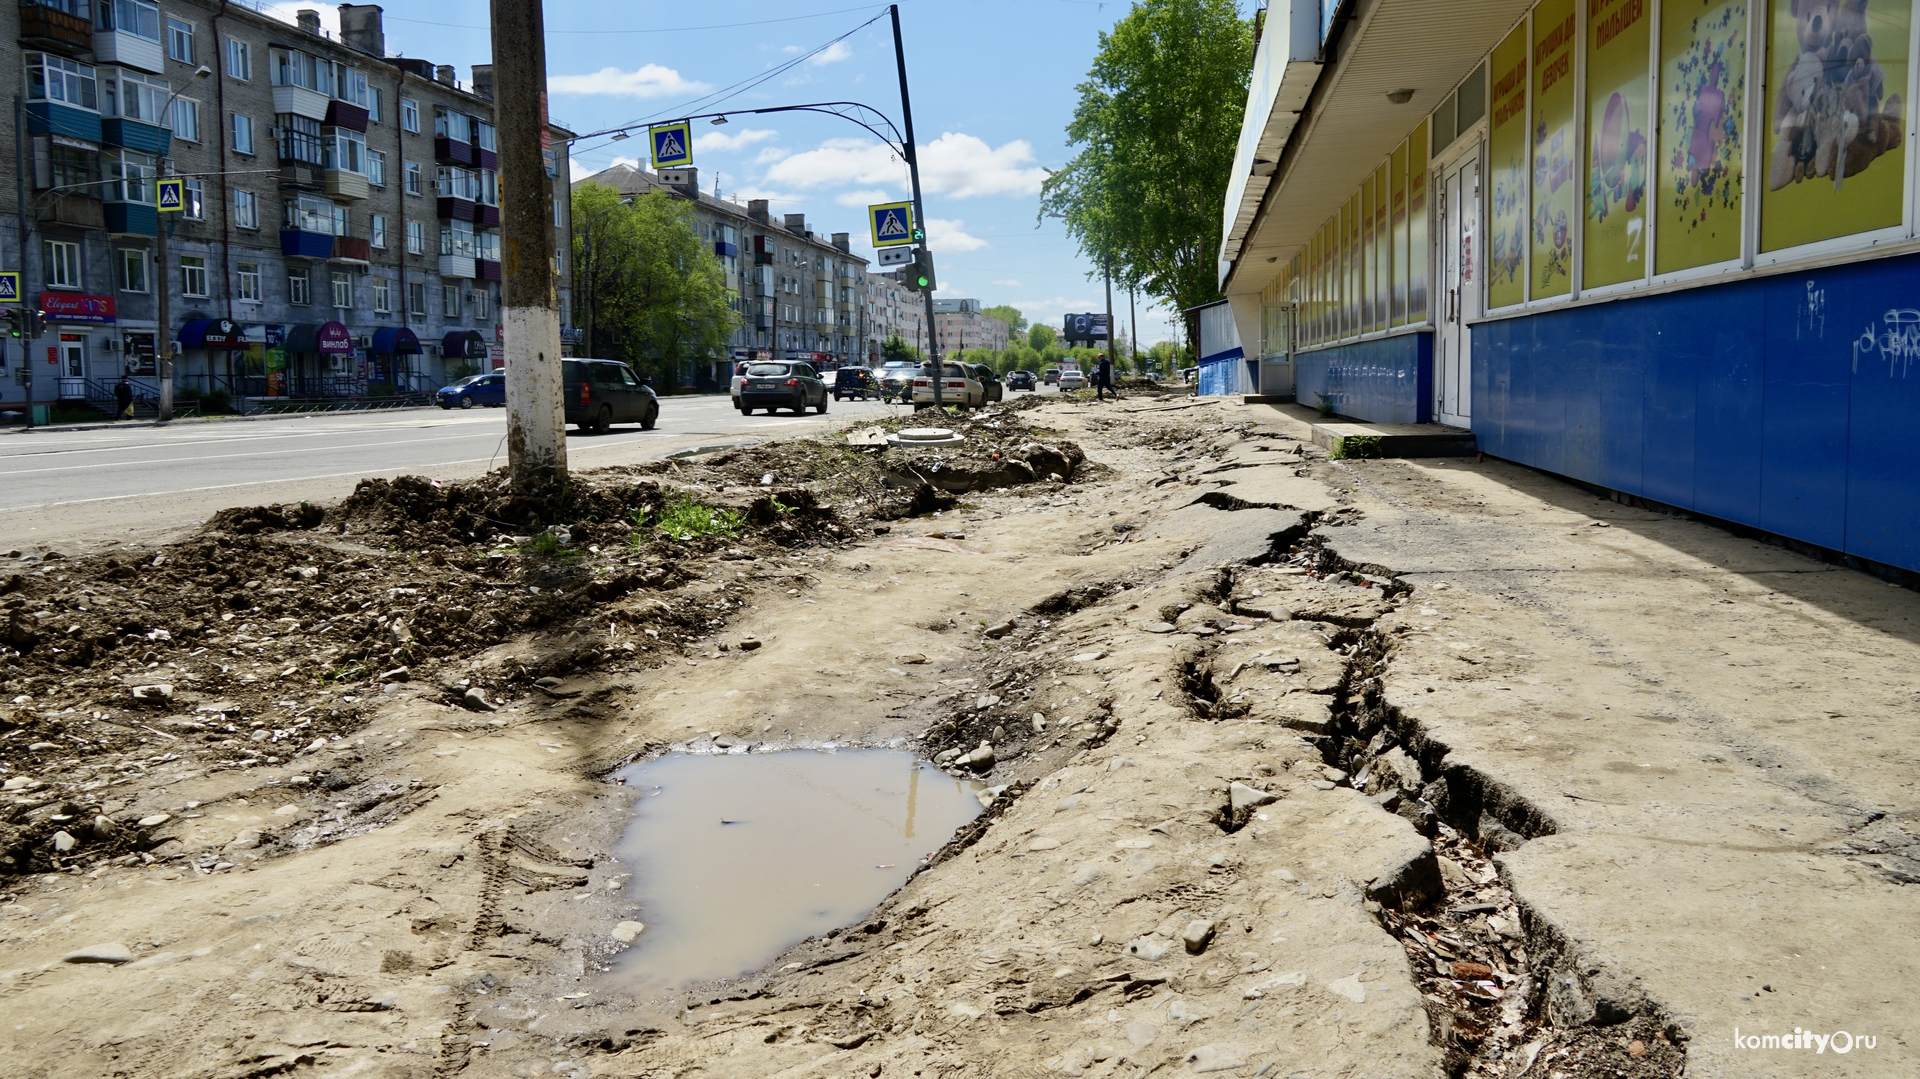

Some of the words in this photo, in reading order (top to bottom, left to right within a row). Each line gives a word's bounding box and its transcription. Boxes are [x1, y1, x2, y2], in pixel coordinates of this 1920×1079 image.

[1542, 50, 1569, 96] ДЕВОЧЕК
[1495, 89, 1525, 130] МАЛЬЧИКОВ
[46, 296, 79, 312] Elegant
[80, 298, 107, 312] KIDS
[322, 339, 348, 349] винлаб
